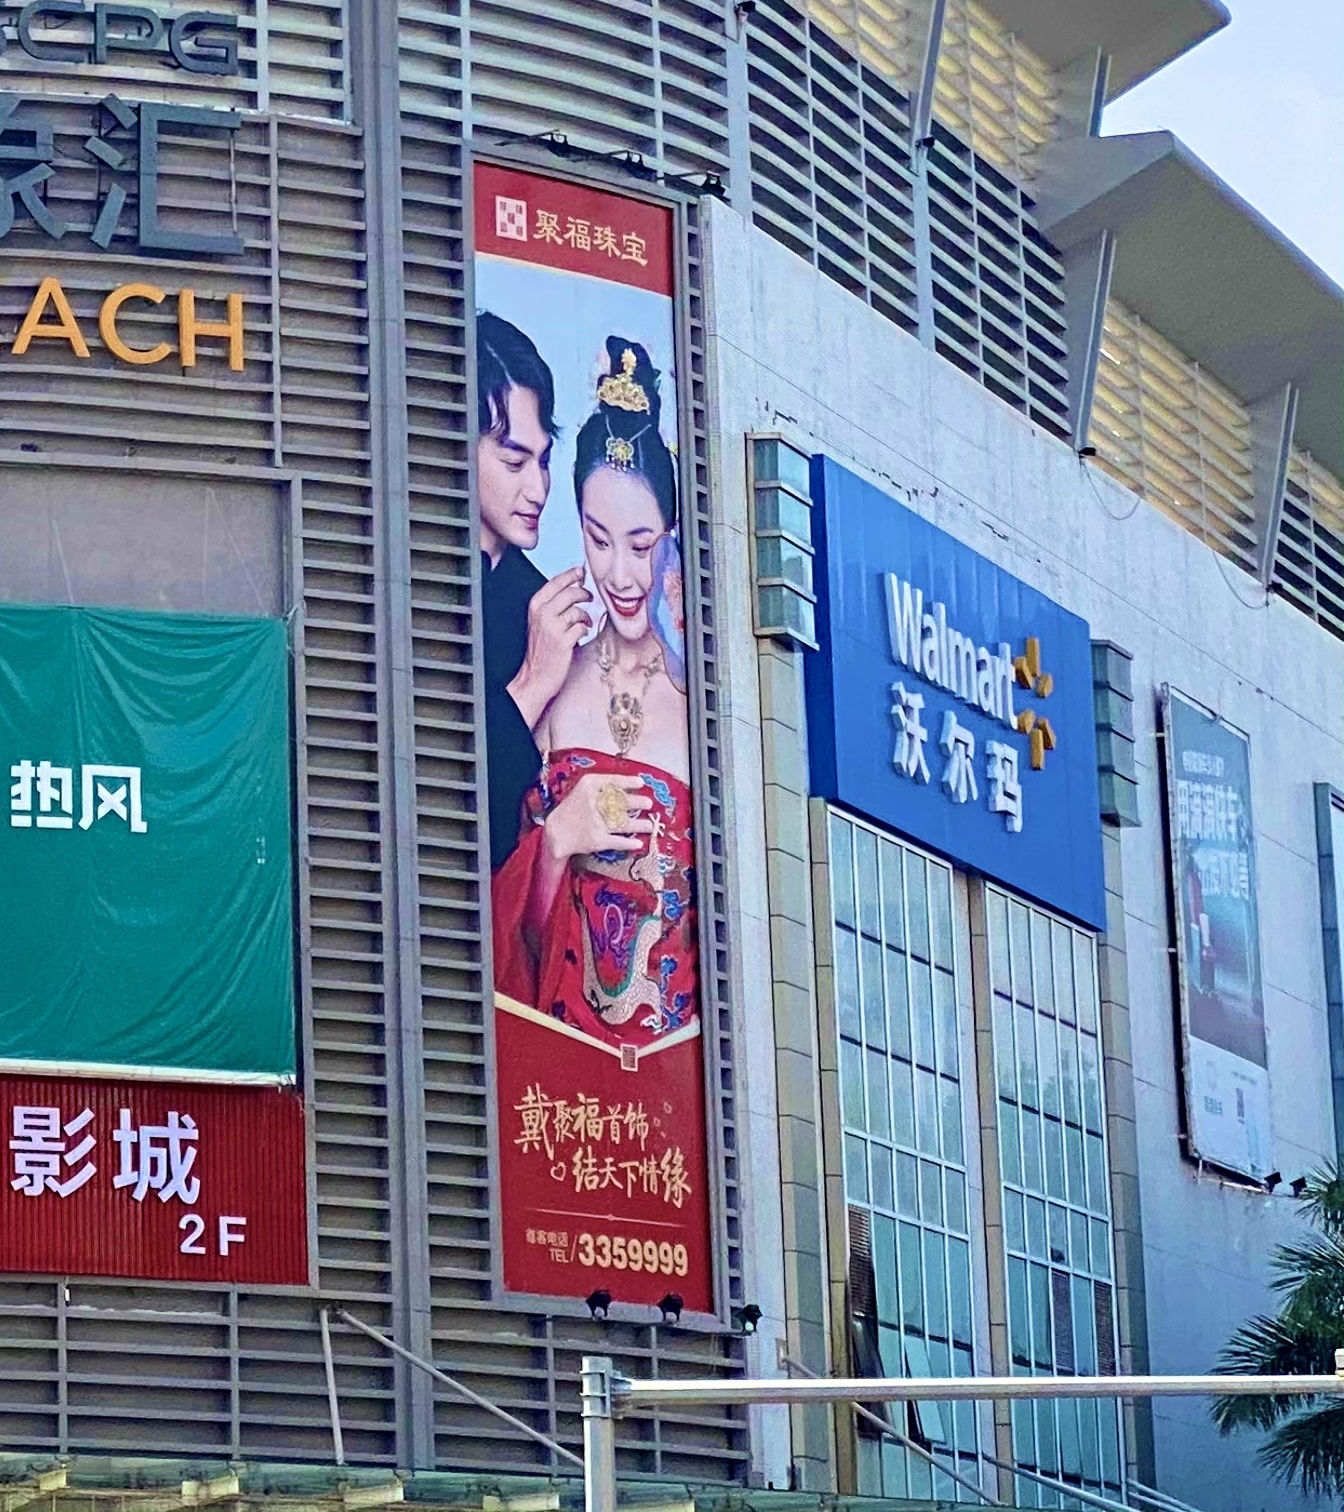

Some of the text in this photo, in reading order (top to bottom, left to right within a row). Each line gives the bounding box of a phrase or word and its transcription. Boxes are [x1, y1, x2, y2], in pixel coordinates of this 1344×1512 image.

[533, 209, 648, 267] 聚福珠宝
[884, 572, 1018, 730] Walmart
[891, 681, 1023, 833] 沃尔玛
[10, 759, 148, 833] 热风
[178, 1213, 248, 1256] 2F
[578, 1233, 689, 1277] 3359999
